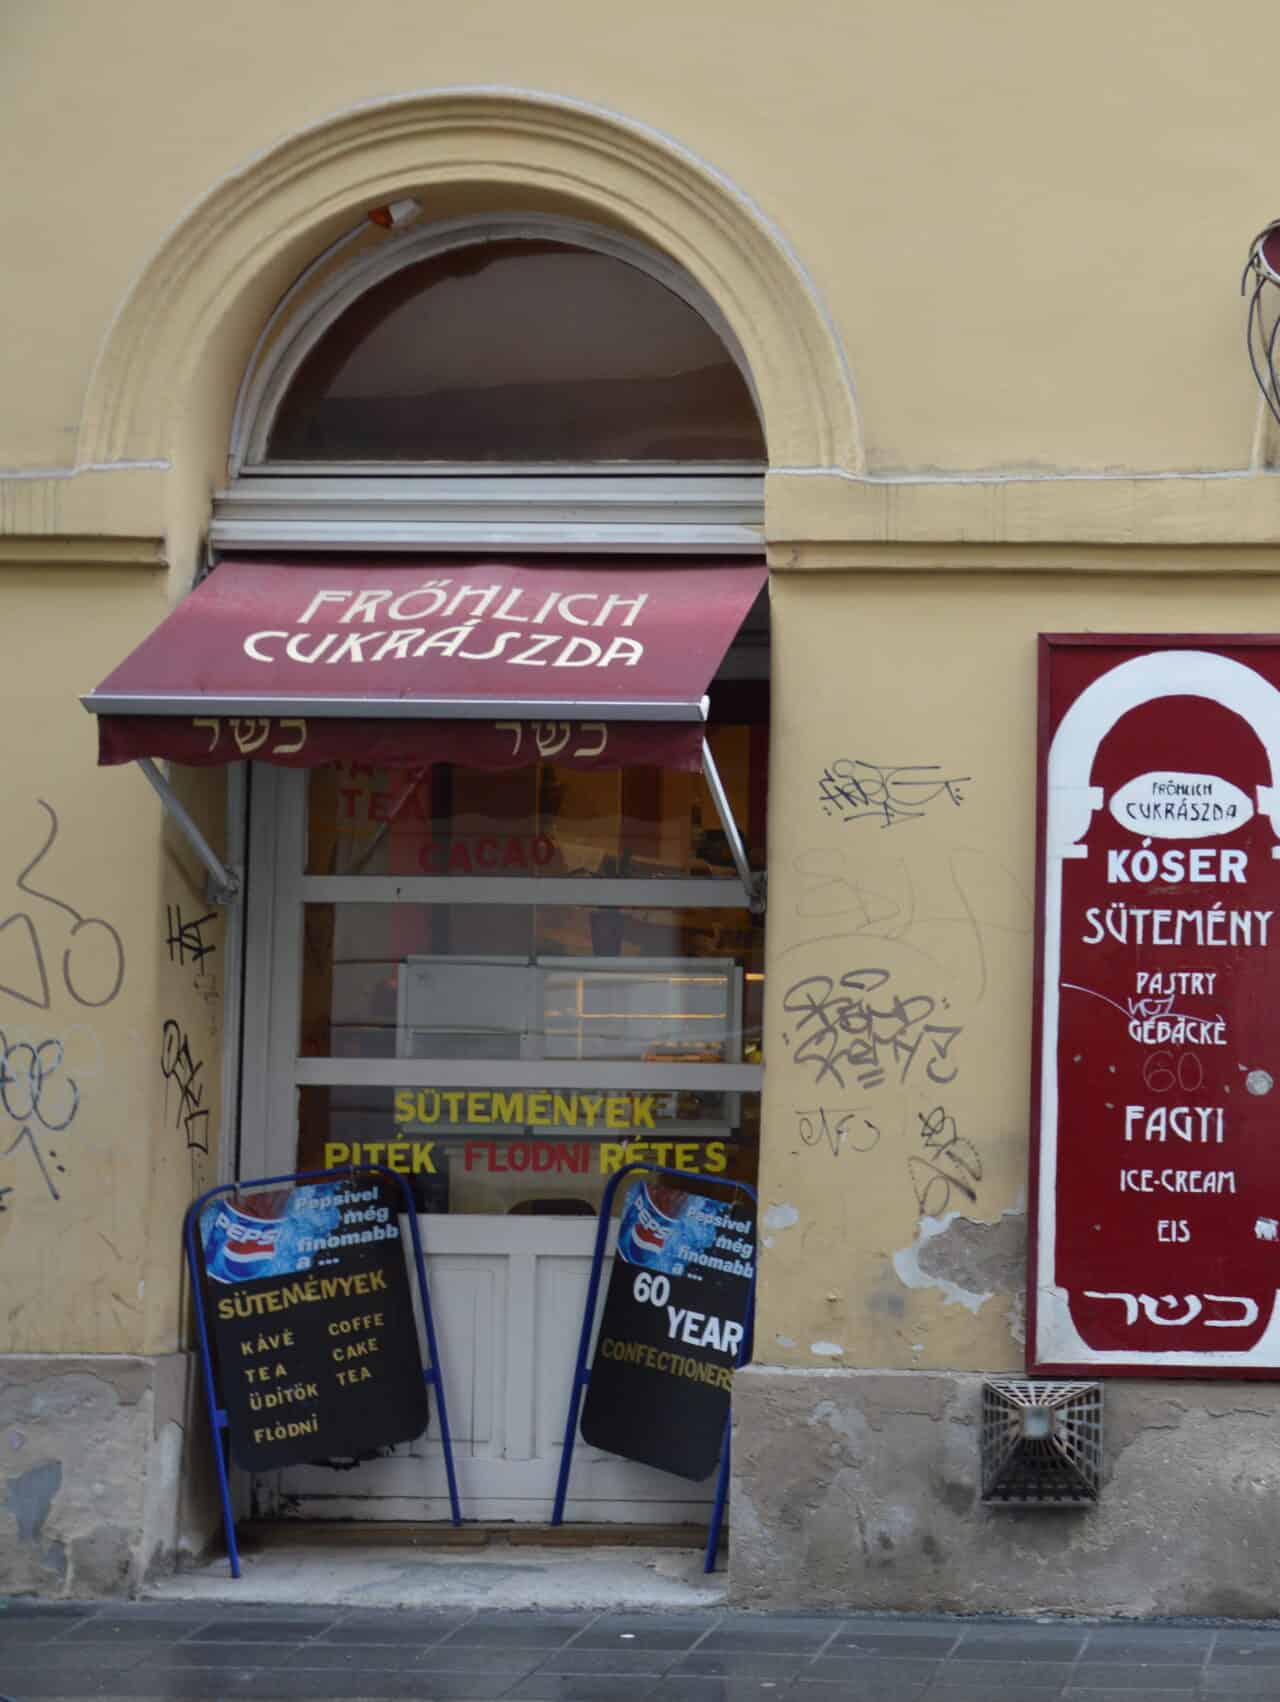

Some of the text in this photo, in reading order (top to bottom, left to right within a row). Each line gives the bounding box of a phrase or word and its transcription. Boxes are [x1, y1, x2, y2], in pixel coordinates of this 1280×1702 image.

[242, 619, 645, 668] CUKRÁSZDA
[1125, 798, 1238, 822] CUKRÁSZDA
[418, 834, 556, 873] CACAO
[1106, 838, 1249, 884] KÓSER
[1081, 901, 1275, 947] SÜTEMÉNY
[1135, 971, 1217, 996] PASTRY
[394, 1086, 657, 1130] SÜTEMÉNYEK
[1124, 1105, 1225, 1143] FAGYI
[464, 1141, 593, 1174] FLODNI
[1119, 1169, 1236, 1194] ICE-CREAM
[342, 1205, 390, 1226] még
[1157, 1219, 1191, 1243] EIS
[295, 1256, 312, 1271] a
[715, 1233, 754, 1260] még
[671, 1263, 684, 1276] a
[217, 1269, 389, 1321] SÜTEMÉNYEK
[632, 1271, 671, 1308] 60
[327, 1313, 385, 1337] COFFE
[1083, 1290, 1260, 1327] כשר
[666, 1305, 746, 1357] YEAR
[244, 1338, 380, 1385] TEA CAKE
[335, 1367, 373, 1387] TEA
